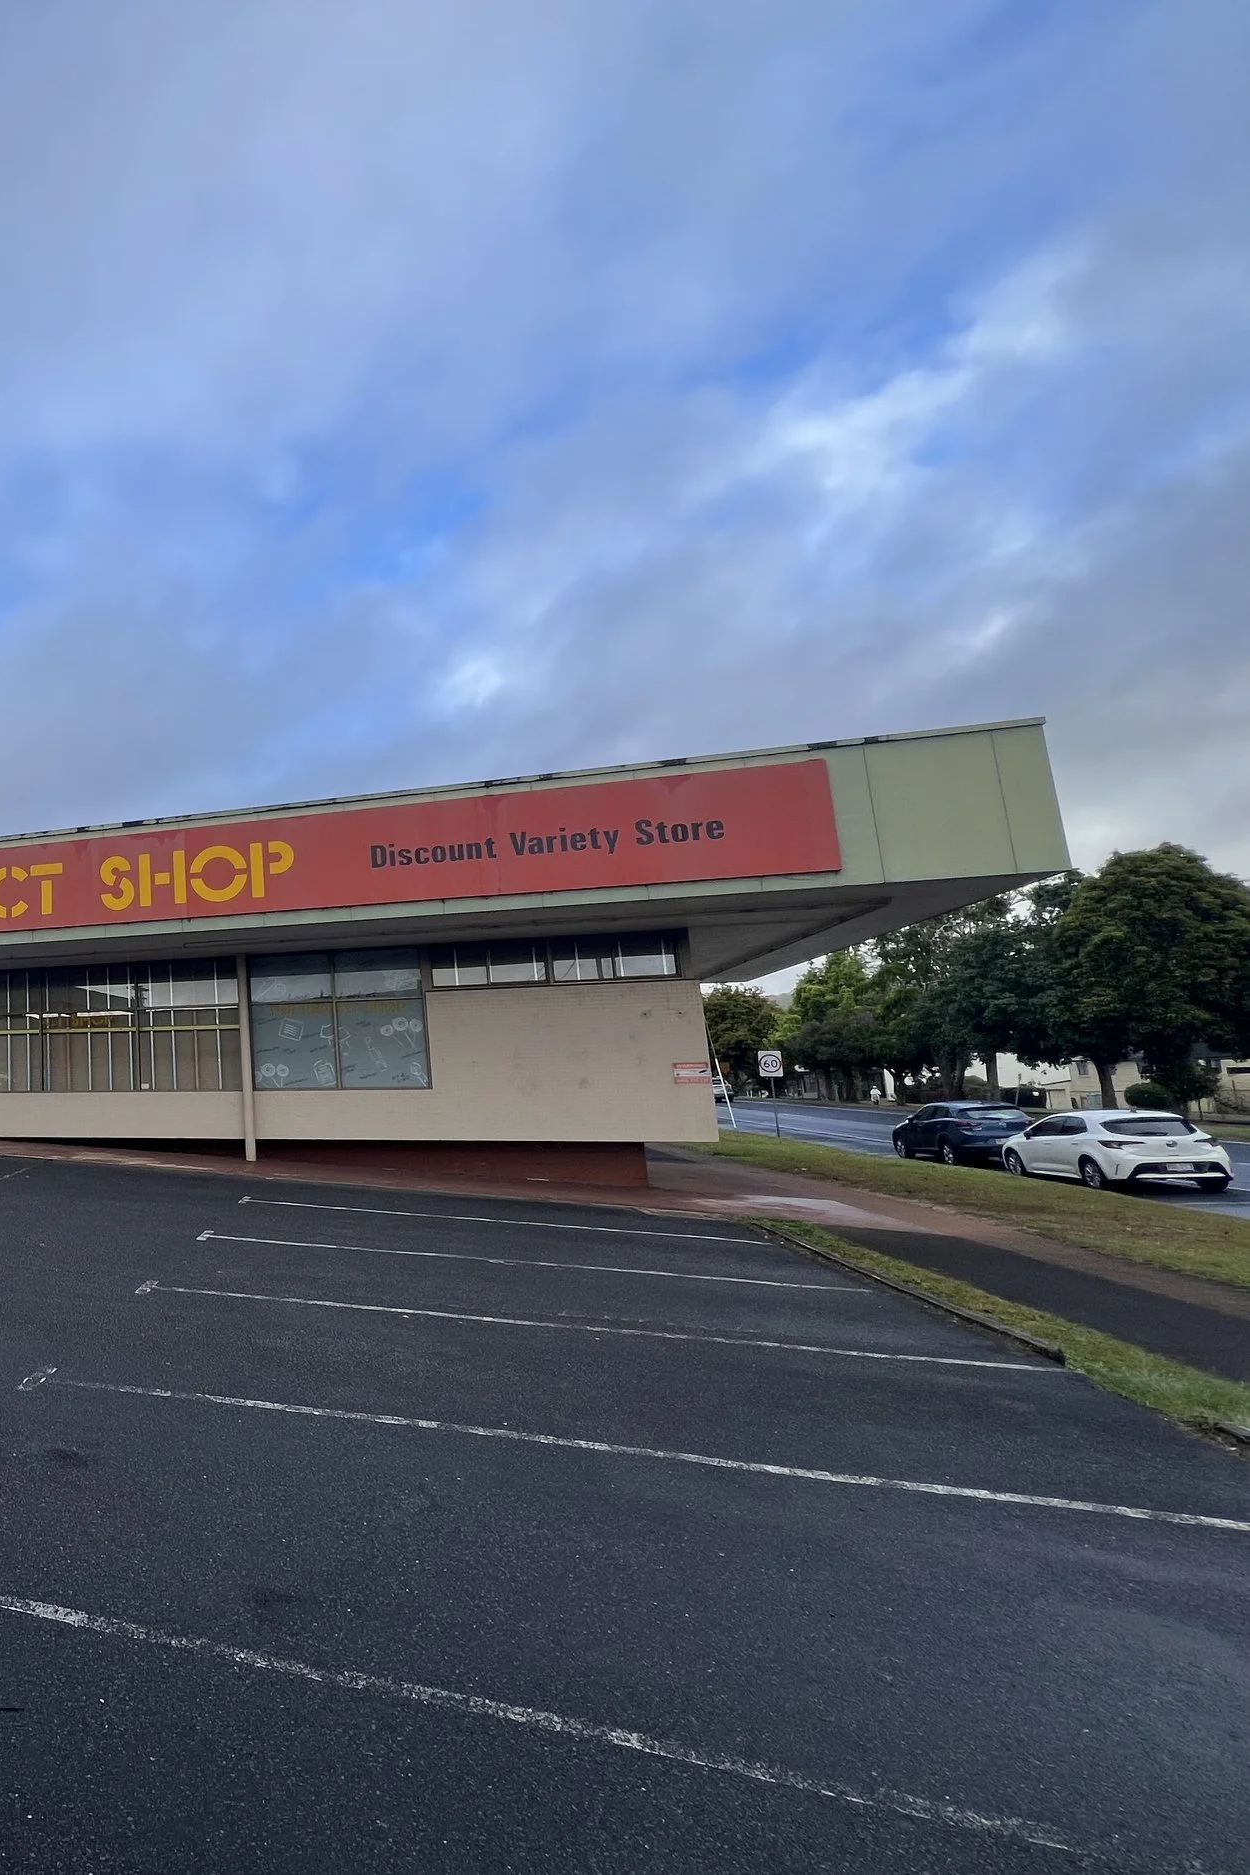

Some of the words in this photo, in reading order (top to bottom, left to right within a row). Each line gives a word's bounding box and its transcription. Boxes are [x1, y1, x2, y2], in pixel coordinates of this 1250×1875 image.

[370, 837, 497, 869] Discount
[509, 827, 619, 856] Variety
[634, 818, 725, 846] Store
[100, 840, 295, 911] SHOP
[763, 1059, 778, 1068] 60
